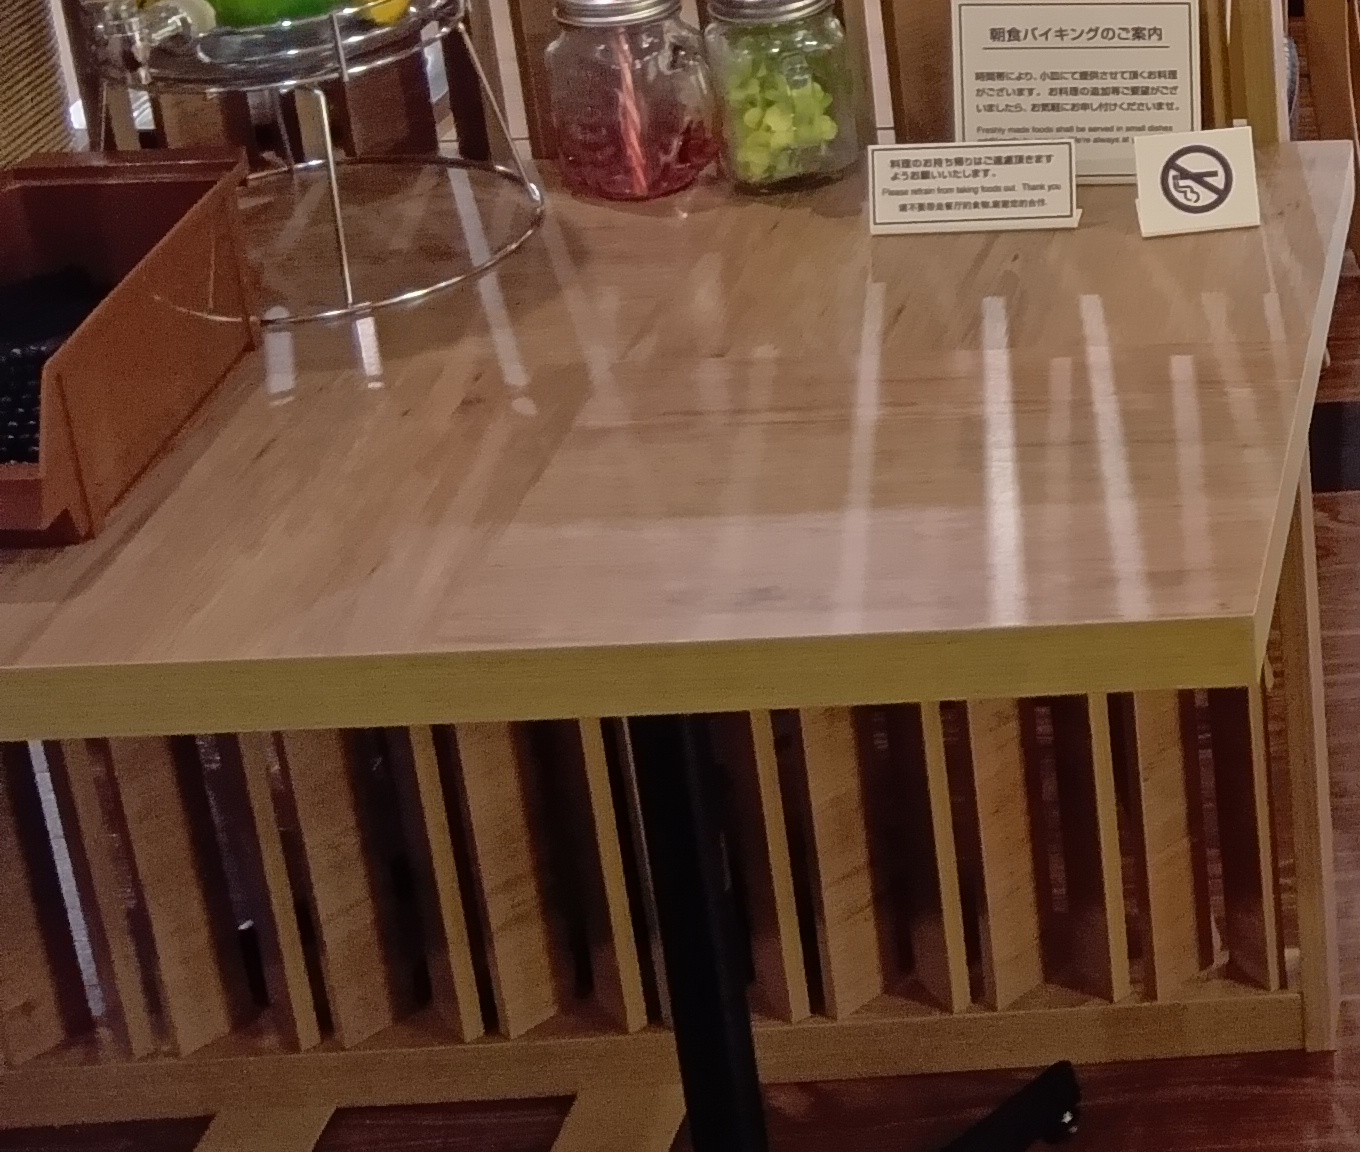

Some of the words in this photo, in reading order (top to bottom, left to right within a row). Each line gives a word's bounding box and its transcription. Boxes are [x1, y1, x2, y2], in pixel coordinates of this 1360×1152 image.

[989, 26, 1164, 42] 朝食バイキングのご案内
[937, 186, 955, 195] from
[1022, 182, 1046, 191] Thank
